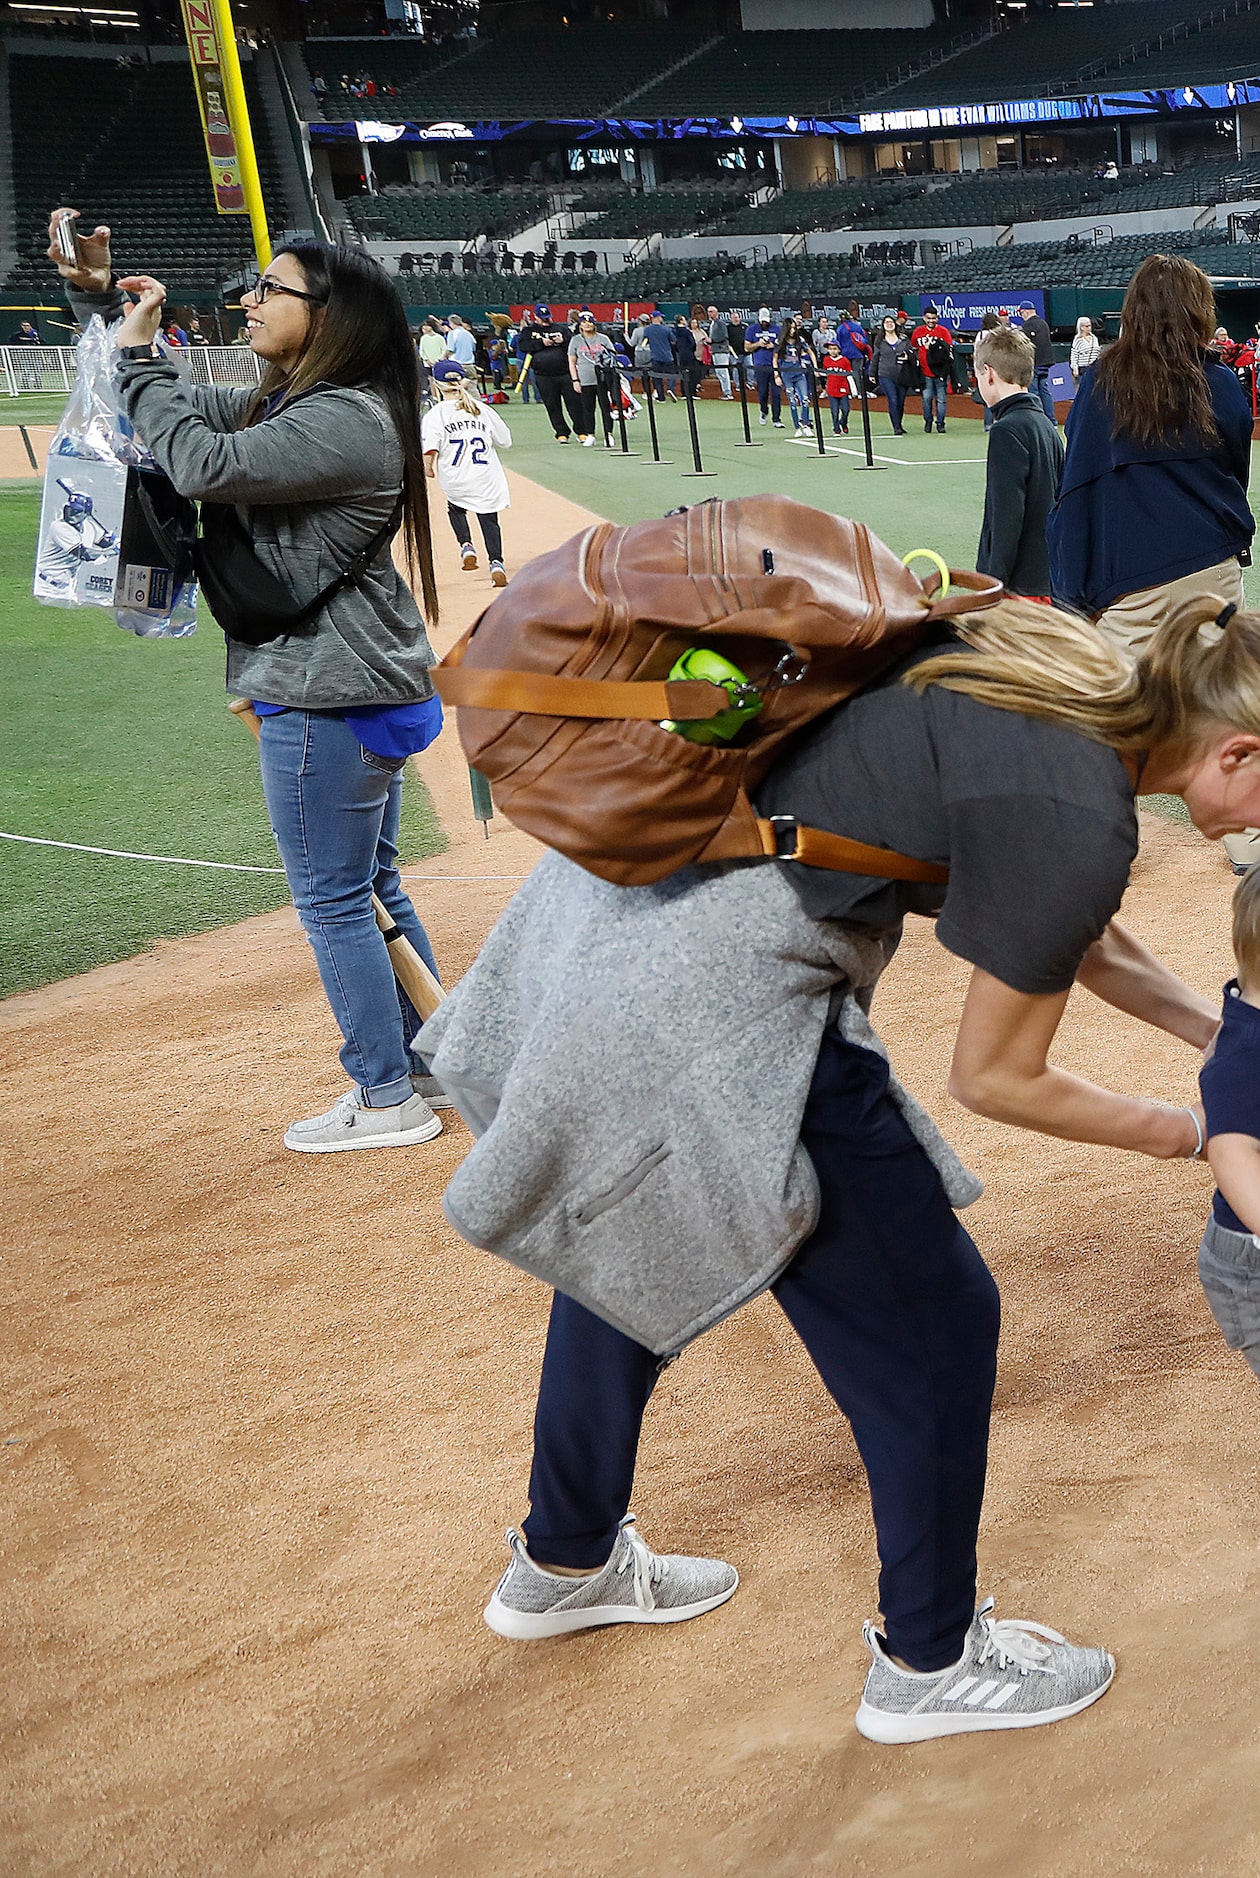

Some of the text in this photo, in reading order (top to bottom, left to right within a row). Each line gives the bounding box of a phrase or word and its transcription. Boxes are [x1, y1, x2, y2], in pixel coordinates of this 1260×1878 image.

[859, 113, 884, 132] FACE
[883, 110, 928, 130] PAINTING
[940, 107, 960, 126] THE
[960, 105, 985, 125] EVAN
[986, 102, 1036, 123] WILLIAMS
[1037, 100, 1081, 120] DUGOUT
[443, 419, 487, 435] CAPTAIN
[449, 437, 490, 467] 72
